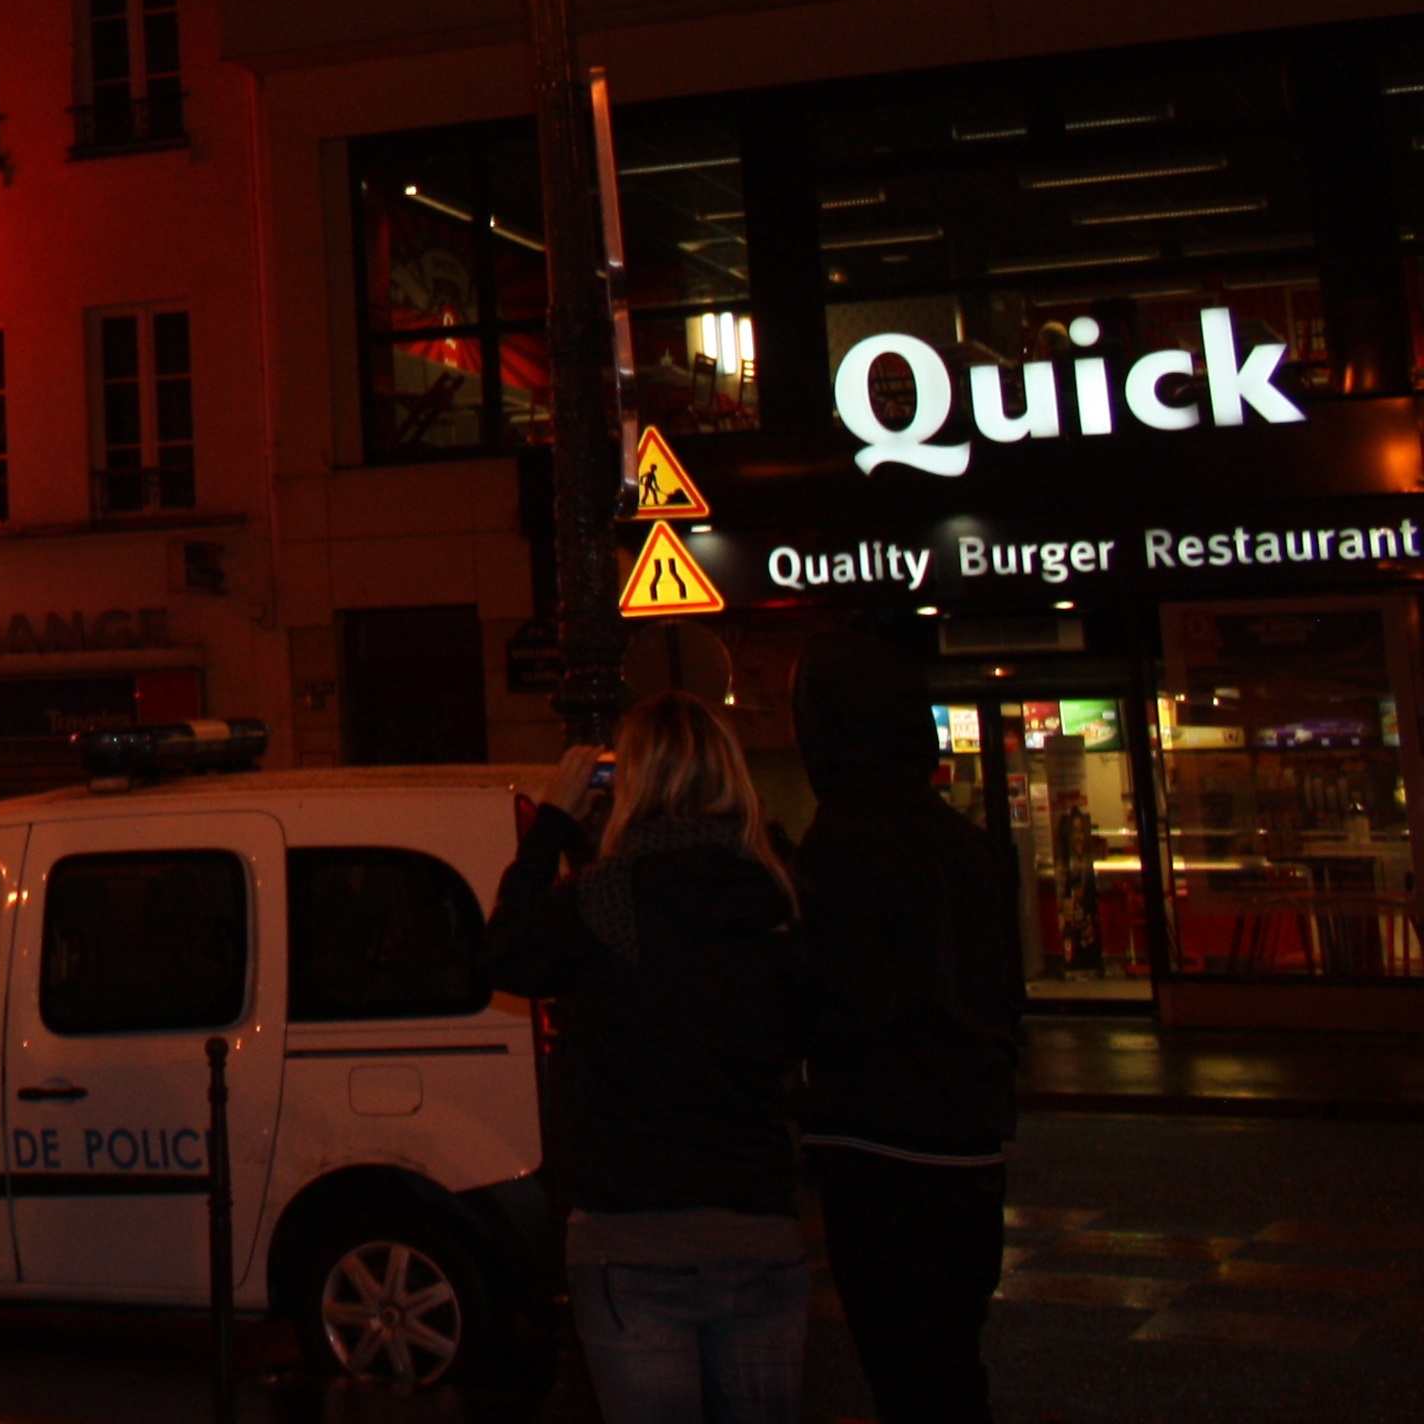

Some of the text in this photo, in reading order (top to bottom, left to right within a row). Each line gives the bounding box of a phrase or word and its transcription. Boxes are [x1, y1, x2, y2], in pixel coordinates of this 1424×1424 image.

[834, 307, 1308, 478] Quick
[767, 518, 1421, 591] Quality Burger Restaurant
[13, 1128, 62, 1169] DE
